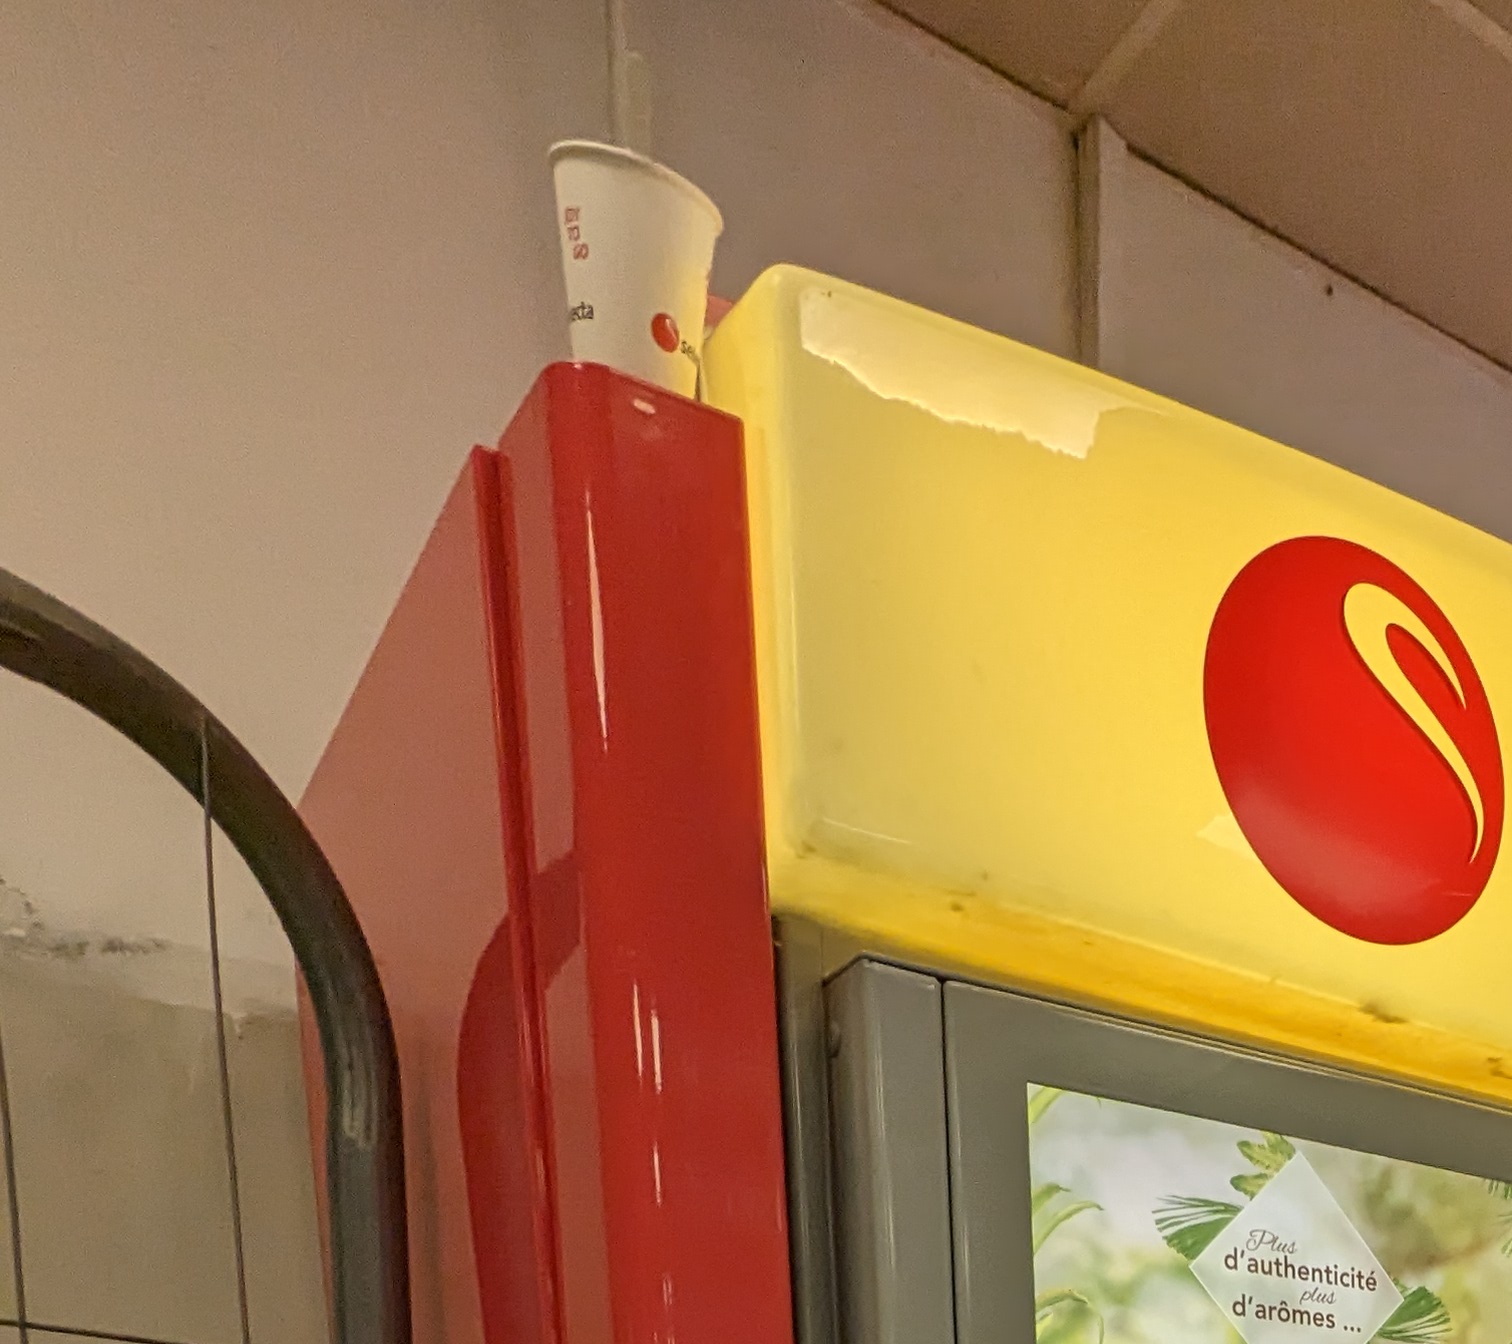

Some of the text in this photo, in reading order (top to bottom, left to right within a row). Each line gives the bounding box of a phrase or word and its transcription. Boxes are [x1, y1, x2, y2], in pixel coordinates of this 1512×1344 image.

[1246, 1229, 1297, 1254] Plus
[1224, 1248, 1377, 1292] d'authenticité
[1300, 1286, 1336, 1305] plus
